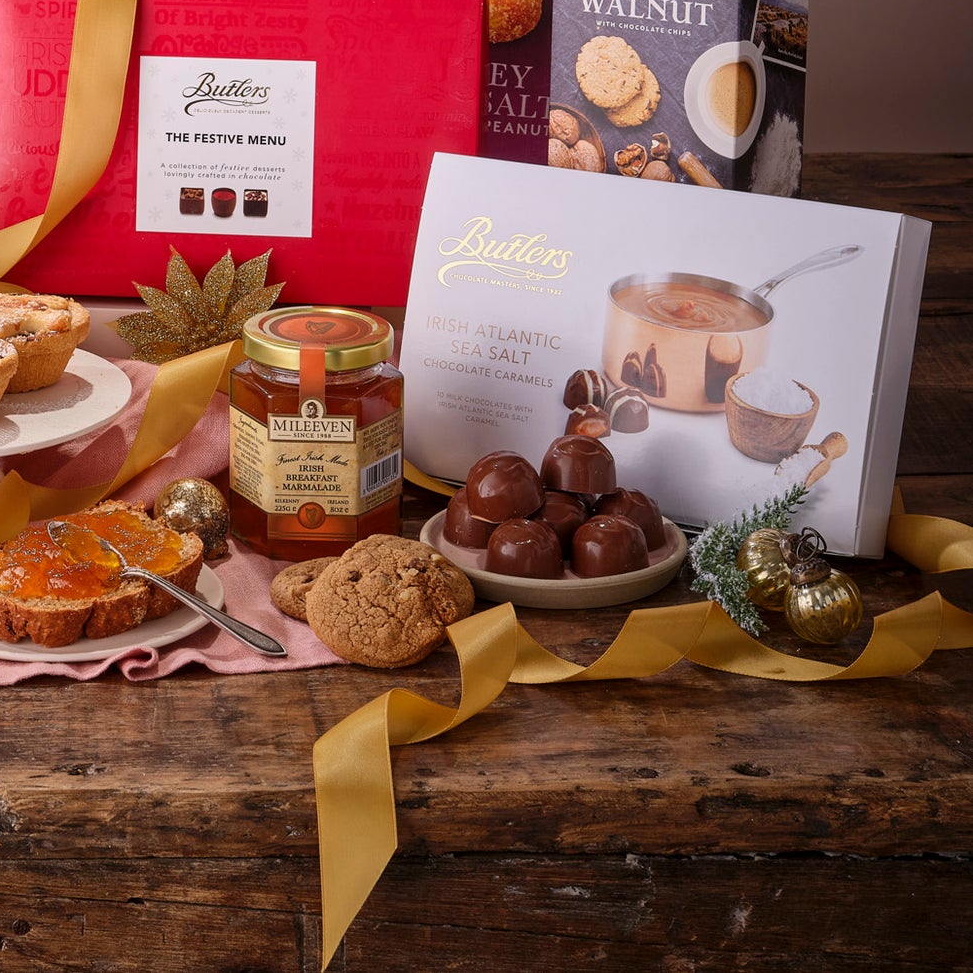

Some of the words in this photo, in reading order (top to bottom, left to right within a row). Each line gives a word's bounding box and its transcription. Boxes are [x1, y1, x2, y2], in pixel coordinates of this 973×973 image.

[154, 10, 181, 25] Of
[185, 9, 246, 31] Bright
[255, 12, 308, 32] Zesty
[595, 20, 616, 29] WITH
[618, 22, 665, 34] CHOCOLATE
[667, 28, 692, 37] CHIPS
[182, 72, 271, 104] Butlers
[165, 132, 190, 142] THE
[194, 133, 244, 145] FESTIVE
[248, 135, 286, 146] MENU
[164, 171, 195, 179] lovingly
[238, 173, 282, 181] chocolate
[220, 163, 250, 173] festive
[438, 216, 573, 272] Butlers
[449, 273, 488, 284] CHOCOLATE
[525, 284, 544, 293] SINCE
[426, 315, 469, 334] IRISH
[474, 323, 562, 350] ATLANTIC
[450, 340, 483, 358] SEA
[488, 345, 531, 365] SALT
[423, 357, 491, 378] CHOCOLATE
[494, 369, 554, 388] CARAMELS
[438, 401, 457, 411] IRISH
[459, 405, 493, 418] ATLANTIC
[495, 411, 510, 419] SEA
[511, 413, 529, 422] SALT
[446, 392, 463, 402] MILK
[464, 395, 513, 411] CHOCOLATES
[514, 404, 534, 415] WITH
[272, 418, 352, 433] MILEEVEN
[465, 415, 500, 428] CARAMEL
[275, 453, 300, 466] Finest
[301, 451, 324, 461] Irish
[299, 464, 324, 473] IRISH
[282, 482, 341, 492] MARMALADE
[286, 474, 339, 483] BREAKFAST
